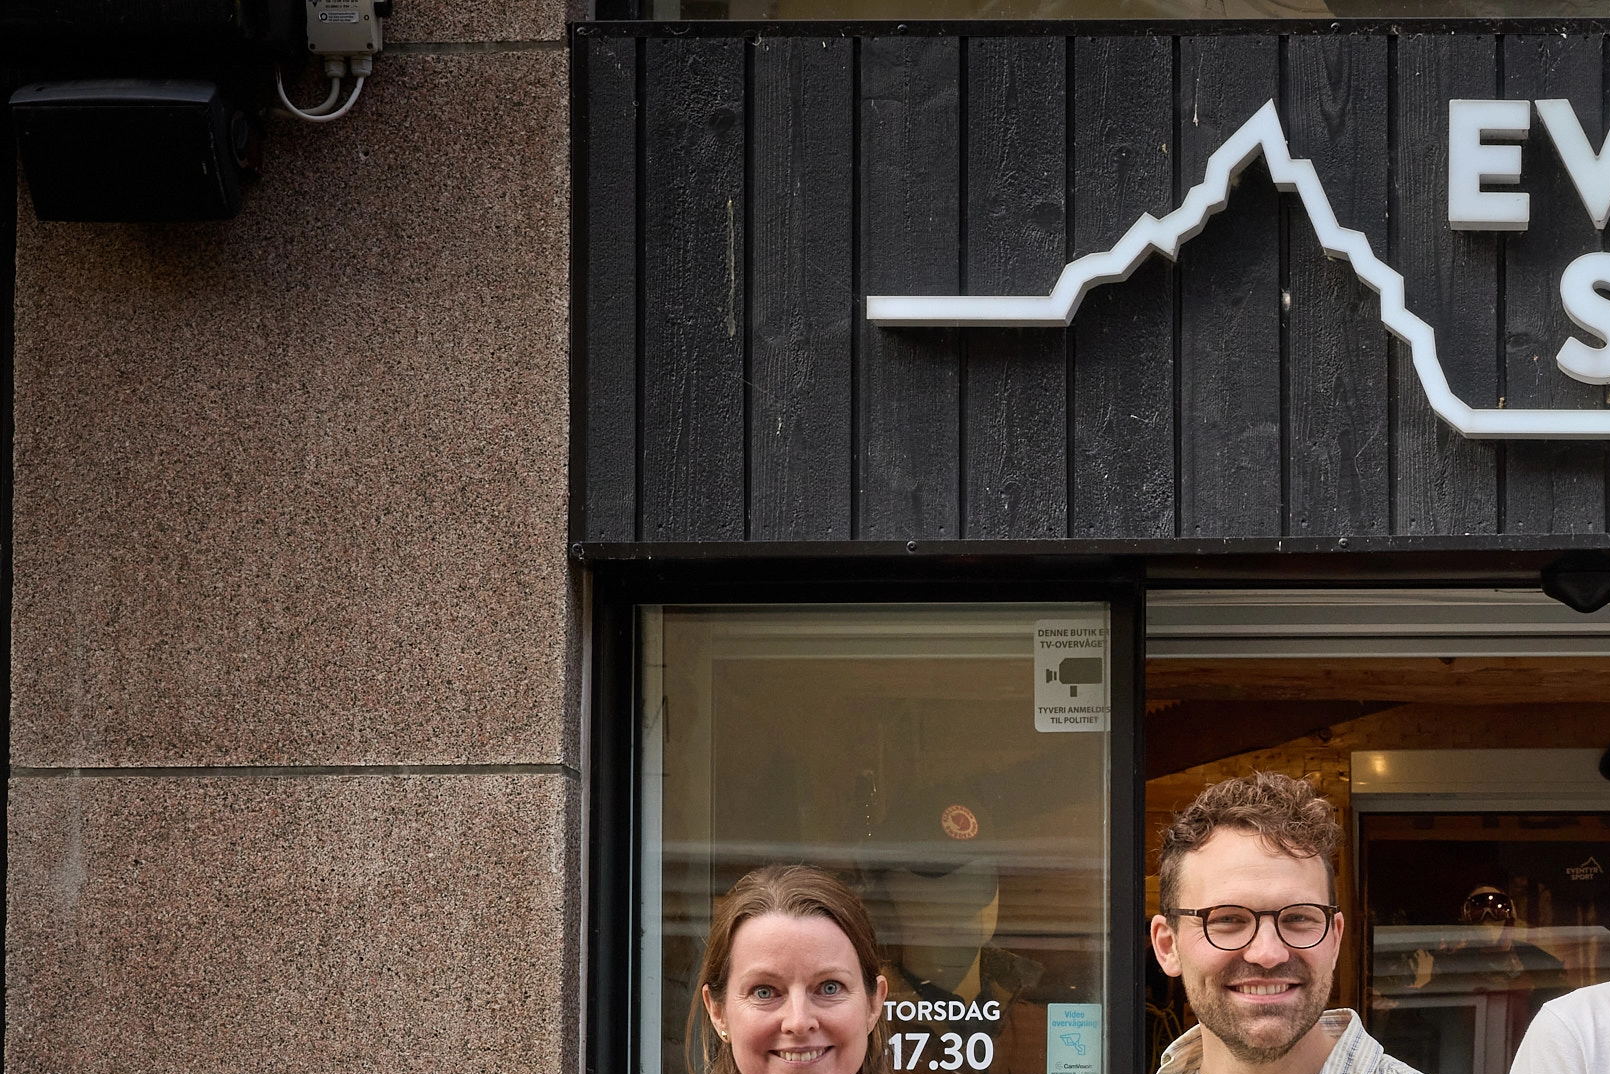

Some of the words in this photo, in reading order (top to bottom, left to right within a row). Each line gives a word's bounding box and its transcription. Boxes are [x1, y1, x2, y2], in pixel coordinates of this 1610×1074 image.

[1038, 629, 1069, 637] DENNE
[1070, 629, 1097, 637] BUTIK
[1038, 706, 1066, 714] TYVERI
[1067, 705, 1111, 714] ANMELDES
[1064, 716, 1098, 724] POLITIET
[1565, 867, 1599, 875] EVENTYR
[884, 1000, 1000, 1021] TORSDAG
[1064, 1011, 1085, 1019] Video
[1051, 1019, 1098, 1028] overvågning
[888, 1032, 994, 1071] 17.30
